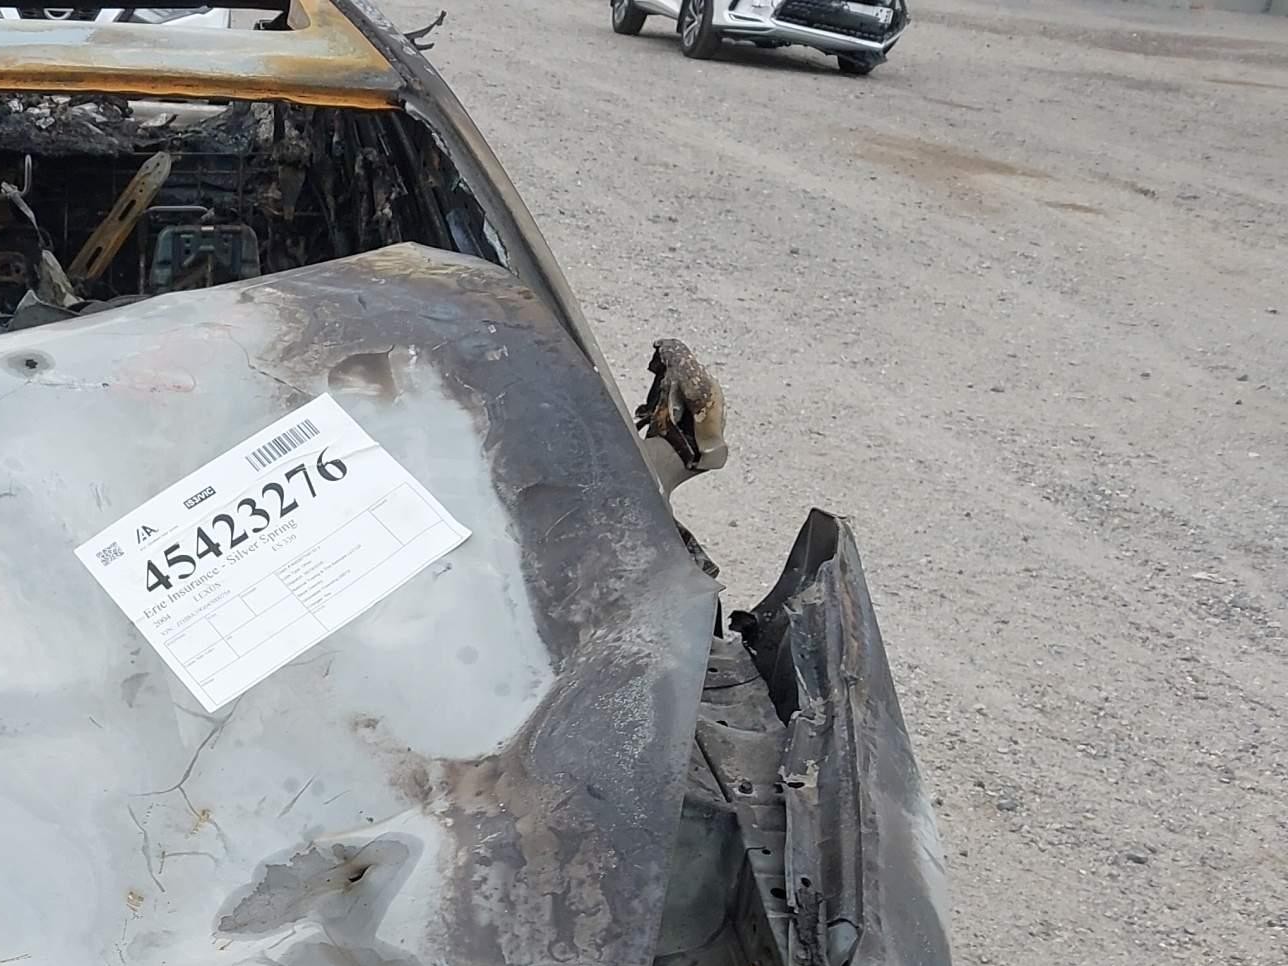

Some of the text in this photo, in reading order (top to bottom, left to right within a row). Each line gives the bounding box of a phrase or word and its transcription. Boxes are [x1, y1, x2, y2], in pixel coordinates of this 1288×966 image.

[144, 600, 168, 619] Erie
[168, 568, 220, 603] Insurance
[225, 543, 261, 567] Silver
[260, 519, 299, 546] Spring
[146, 446, 348, 593] 45423276
